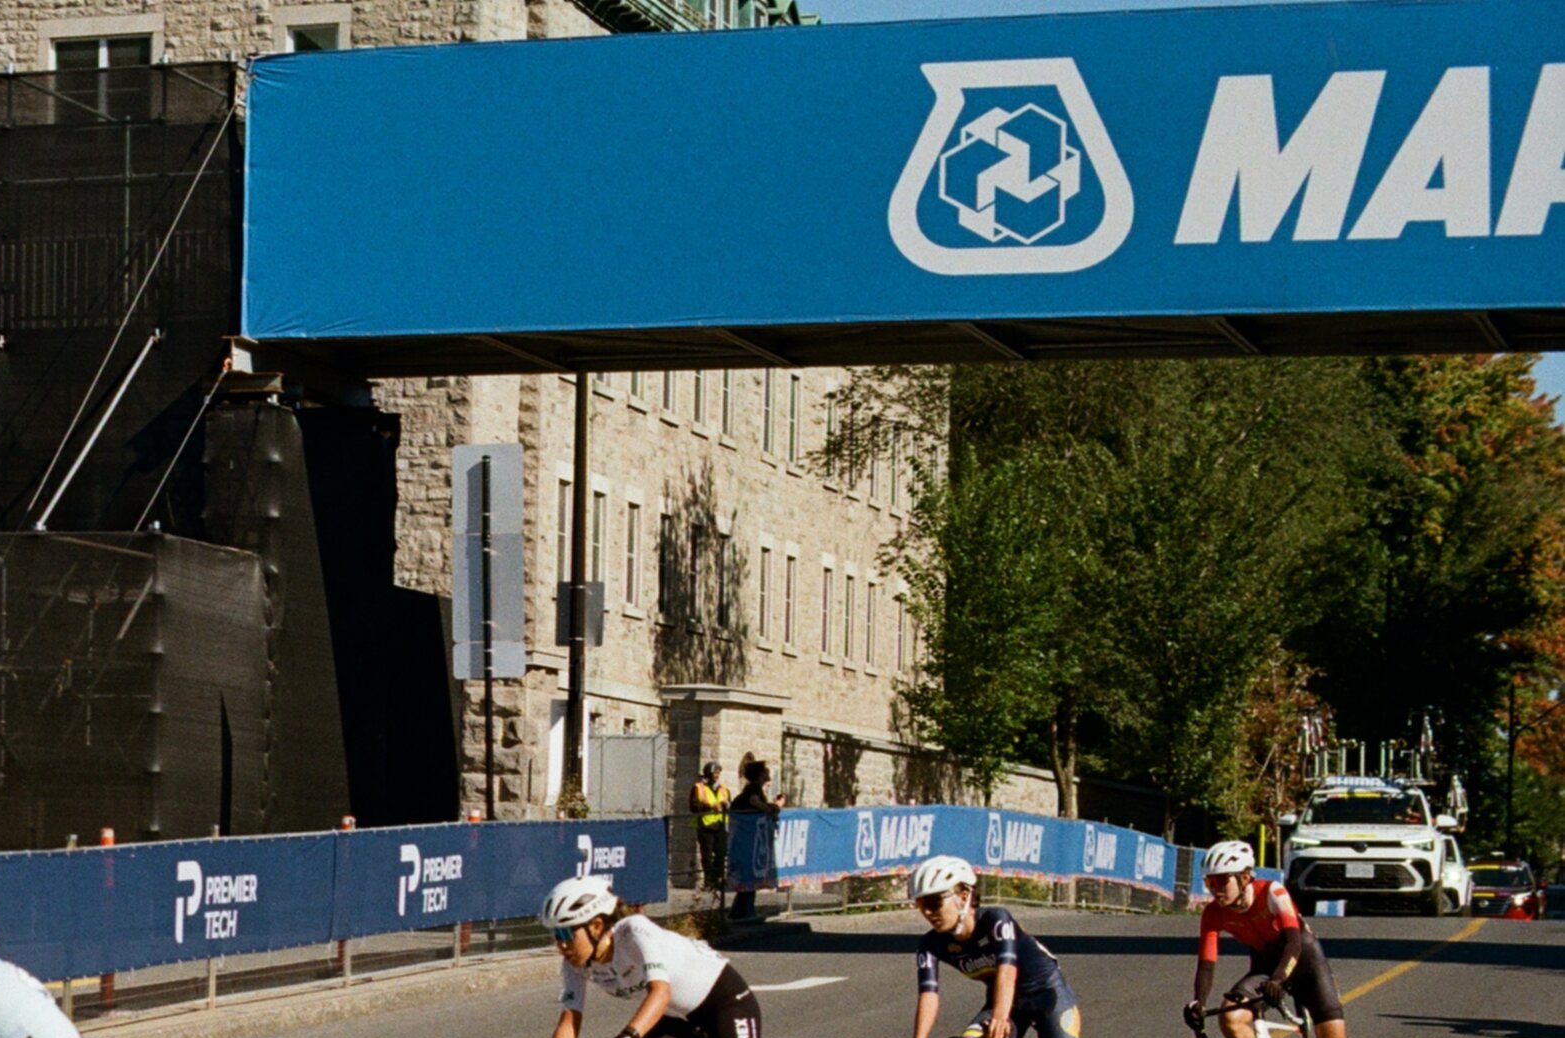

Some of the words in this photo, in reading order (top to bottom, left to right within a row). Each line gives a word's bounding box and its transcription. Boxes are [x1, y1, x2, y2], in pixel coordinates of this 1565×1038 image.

[878, 814, 935, 861] MAPEI
[1004, 820, 1044, 864] MAPEI
[422, 854, 462, 883] PREMIER
[593, 846, 626, 870] PREMIER
[205, 874, 258, 905] PREMIER
[421, 886, 448, 914] TECH
[204, 909, 238, 940] TECH
